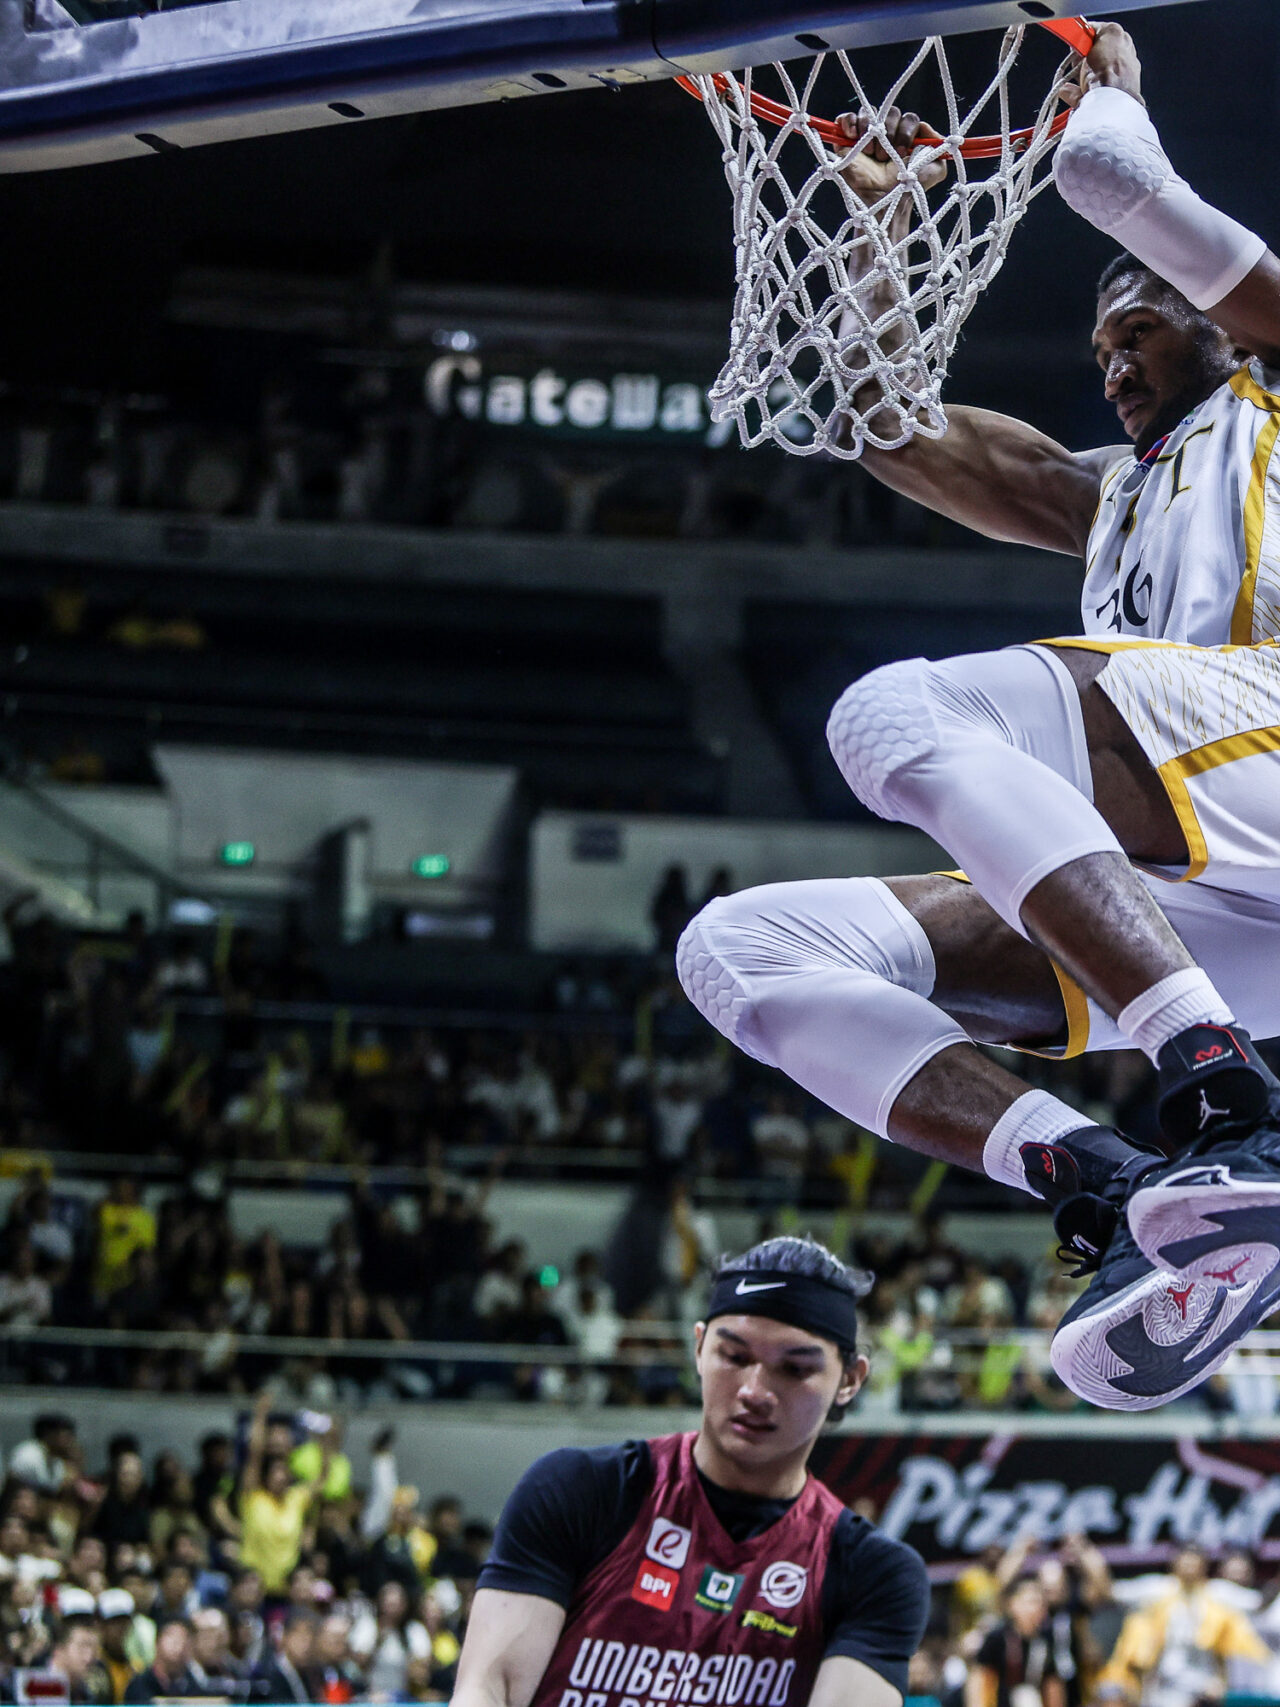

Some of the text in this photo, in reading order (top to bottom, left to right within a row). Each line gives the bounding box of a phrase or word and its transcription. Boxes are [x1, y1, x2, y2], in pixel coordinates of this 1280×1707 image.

[879, 1456, 1118, 1552] Pizza
[640, 1572, 672, 1598] BPI
[568, 1638, 796, 1706] UNIBERSIDAD
